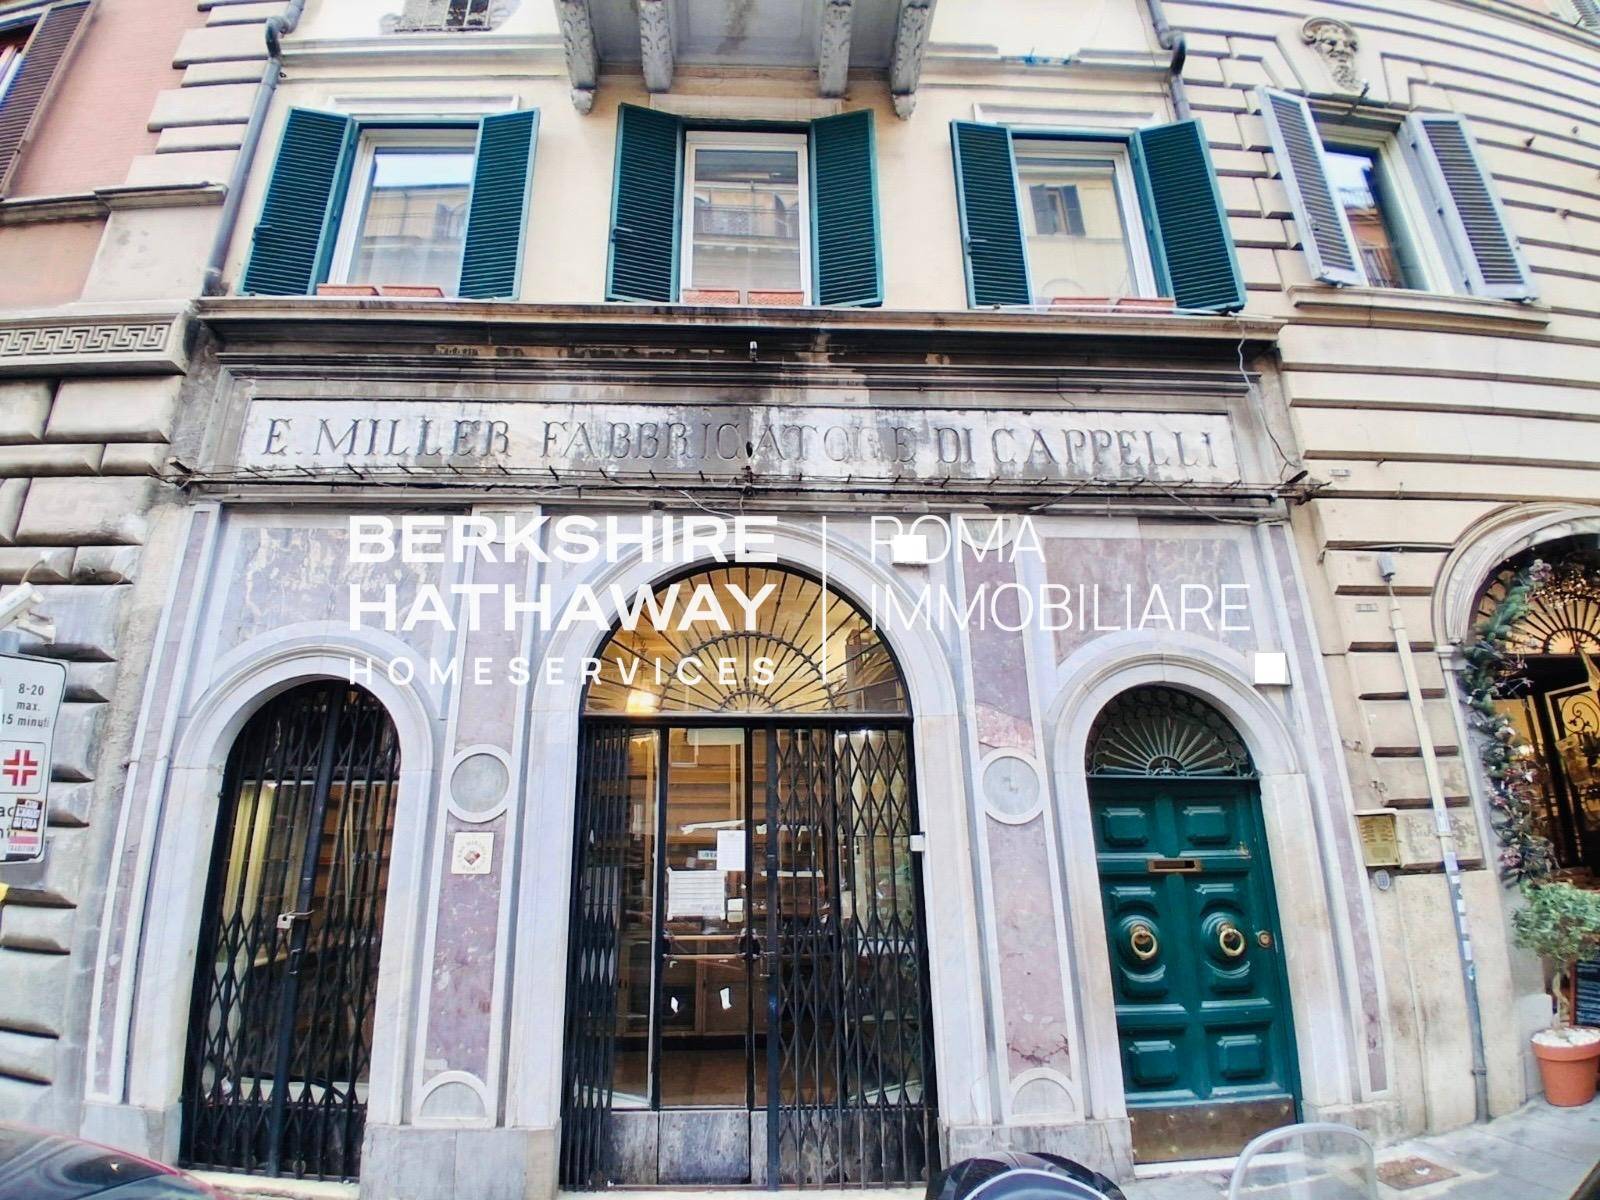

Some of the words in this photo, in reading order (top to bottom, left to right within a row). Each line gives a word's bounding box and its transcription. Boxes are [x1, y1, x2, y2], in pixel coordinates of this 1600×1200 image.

[312, 417, 512, 458] MILLER
[541, 419, 918, 464] FABBRICATORE
[934, 427, 975, 464] DI
[990, 427, 1217, 468] CAPPELLI
[18, 683, 44, 696] 8-20
[16, 701, 40, 712] max.
[2, 713, 13, 725] 15
